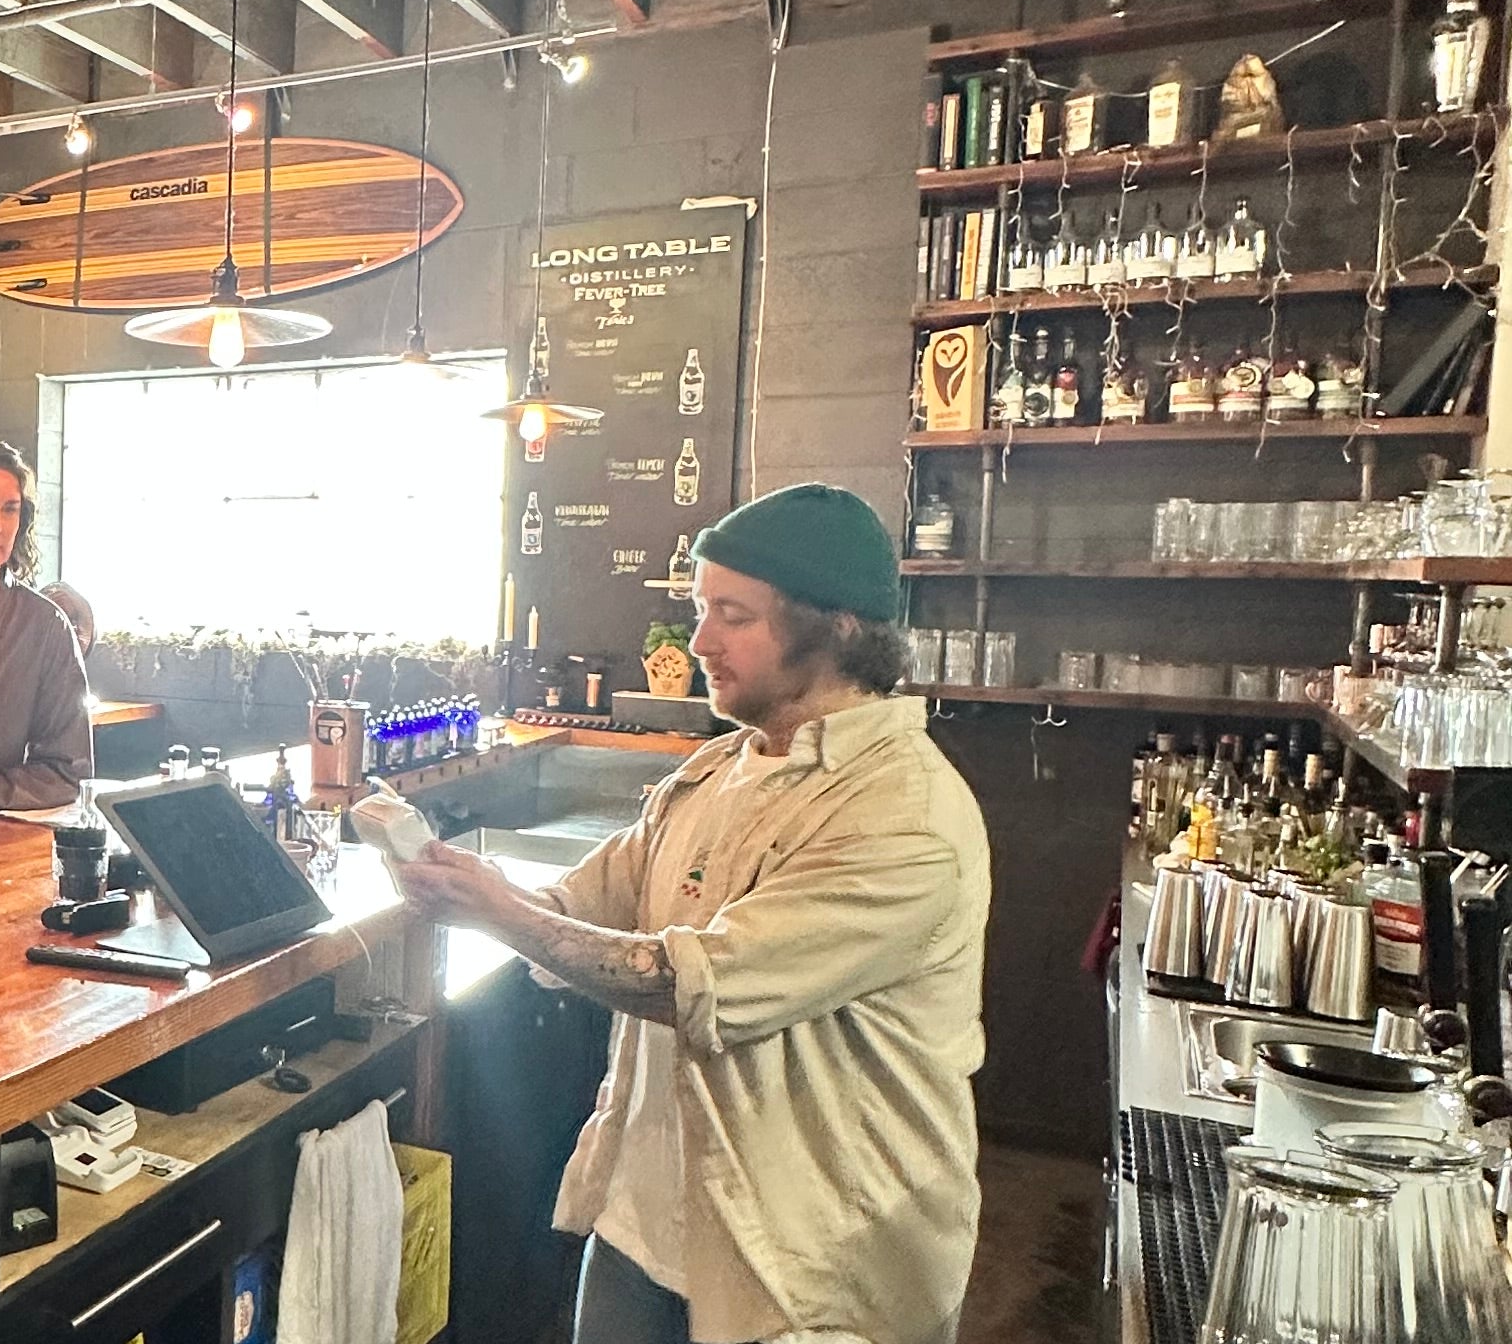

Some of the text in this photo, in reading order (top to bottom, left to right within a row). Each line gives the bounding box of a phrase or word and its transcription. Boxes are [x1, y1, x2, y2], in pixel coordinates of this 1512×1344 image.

[129, 177, 208, 201] cascadia
[531, 235, 731, 269] LONG TABLE
